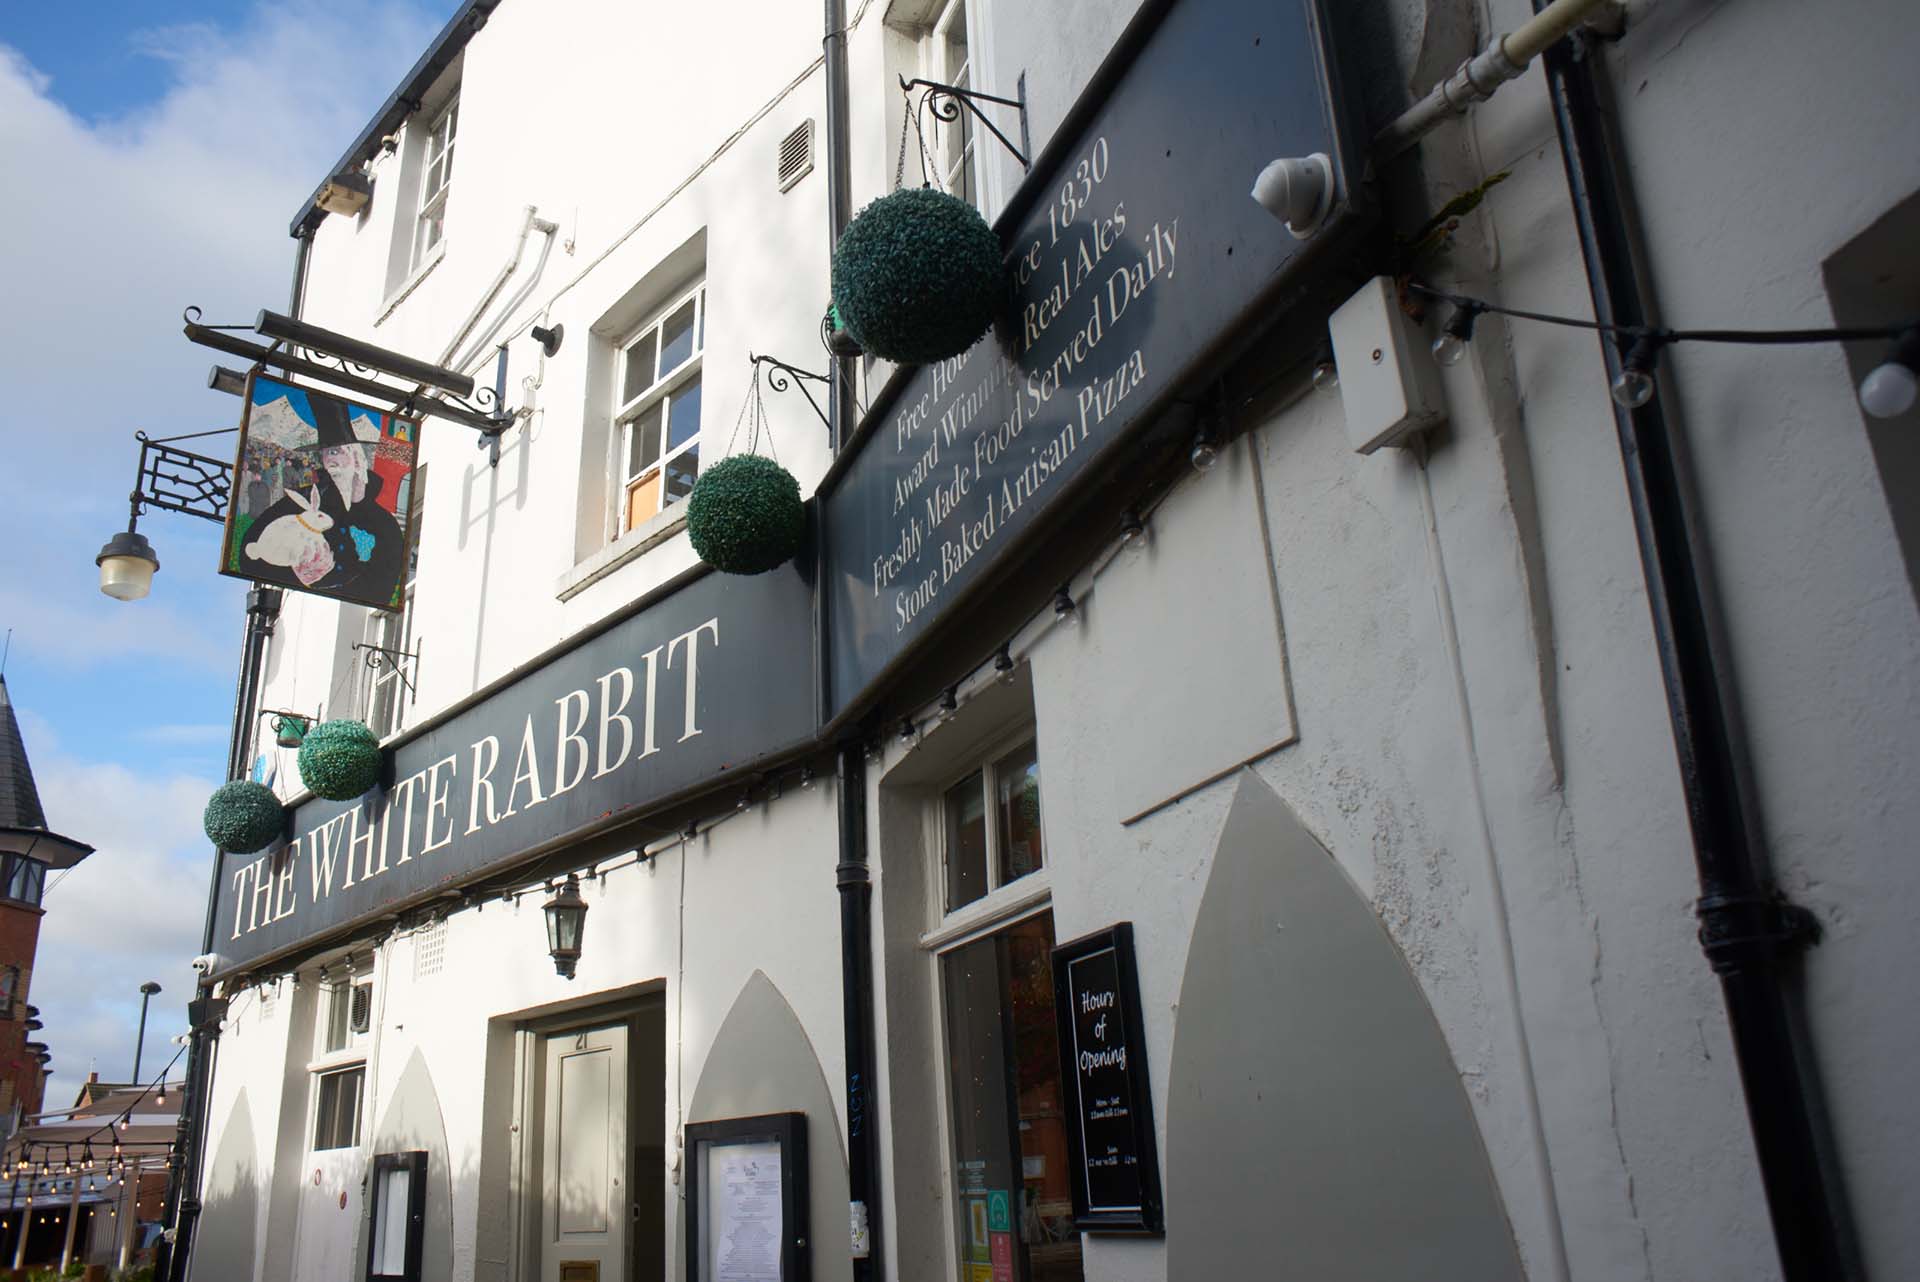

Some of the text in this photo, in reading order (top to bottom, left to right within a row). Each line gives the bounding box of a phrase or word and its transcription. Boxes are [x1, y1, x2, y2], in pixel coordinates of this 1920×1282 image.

[873, 215, 1180, 599] Freshly Made Food Served Daily
[892, 426, 939, 517] Award
[1024, 256, 1072, 352] Real
[1074, 201, 1127, 293] Ales
[896, 392, 929, 454] Free
[1047, 136, 1109, 249] 1830
[895, 349, 1148, 633] Stone Baked Artisan Pizza
[231, 616, 720, 941] THE WHITE RABBIT
[575, 1032, 588, 1051] 21
[1080, 1045, 1126, 1077] Opening
[1081, 990, 1115, 1014] Hours
[1094, 1013, 1107, 1041] of
